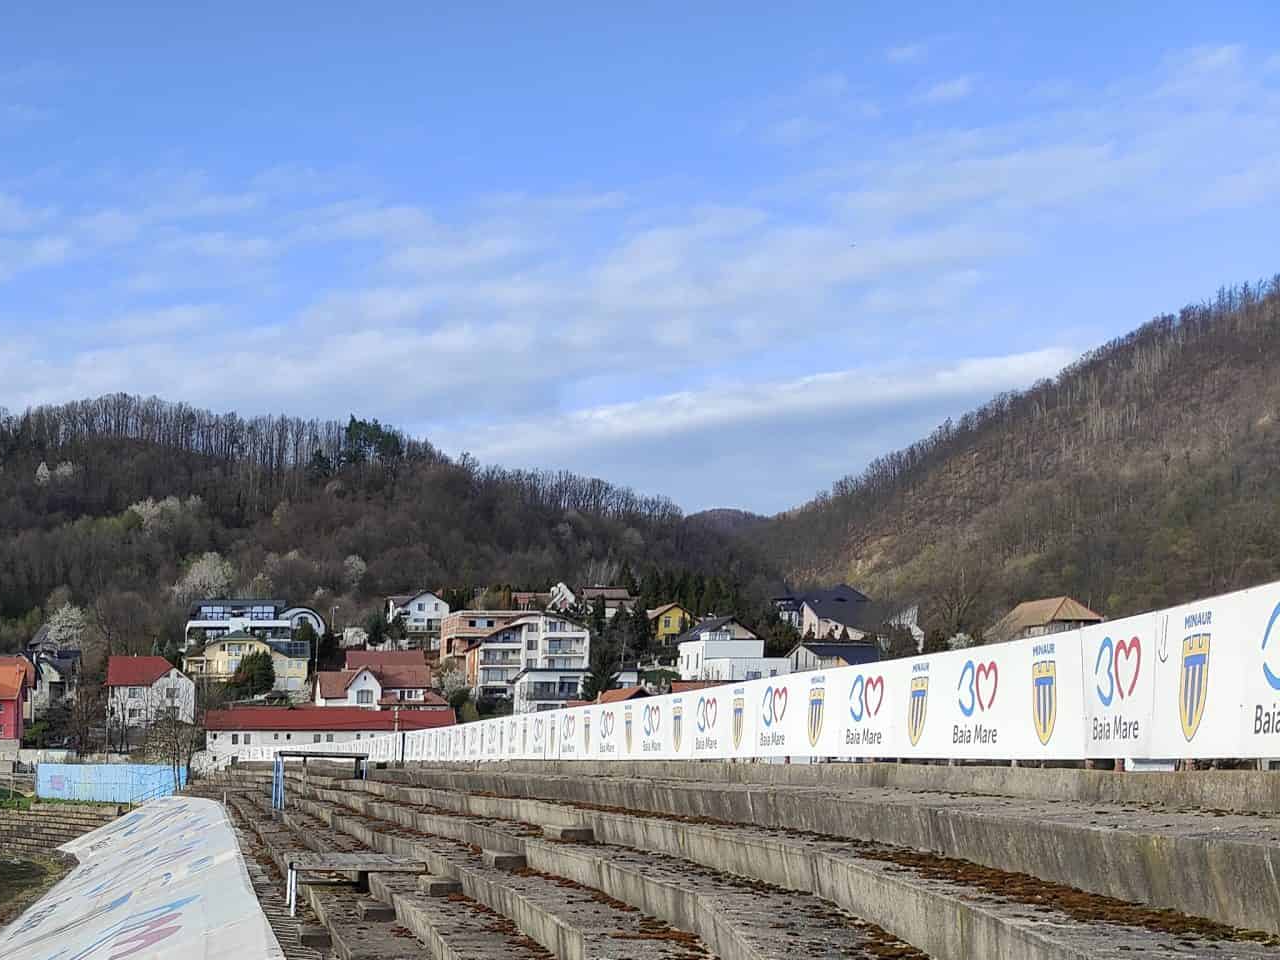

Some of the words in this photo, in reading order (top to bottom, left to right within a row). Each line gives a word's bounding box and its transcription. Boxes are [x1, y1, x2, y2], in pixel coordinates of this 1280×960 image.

[1184, 611, 1213, 629] MINAUR
[1032, 643, 1056, 657] MINAUR
[845, 728, 861, 745] Baia
[861, 729, 882, 745] Mare
[952, 724, 971, 744] Baia
[973, 725, 998, 744] Mare
[1092, 716, 1111, 741] Baia
[1112, 715, 1139, 740] Mare
